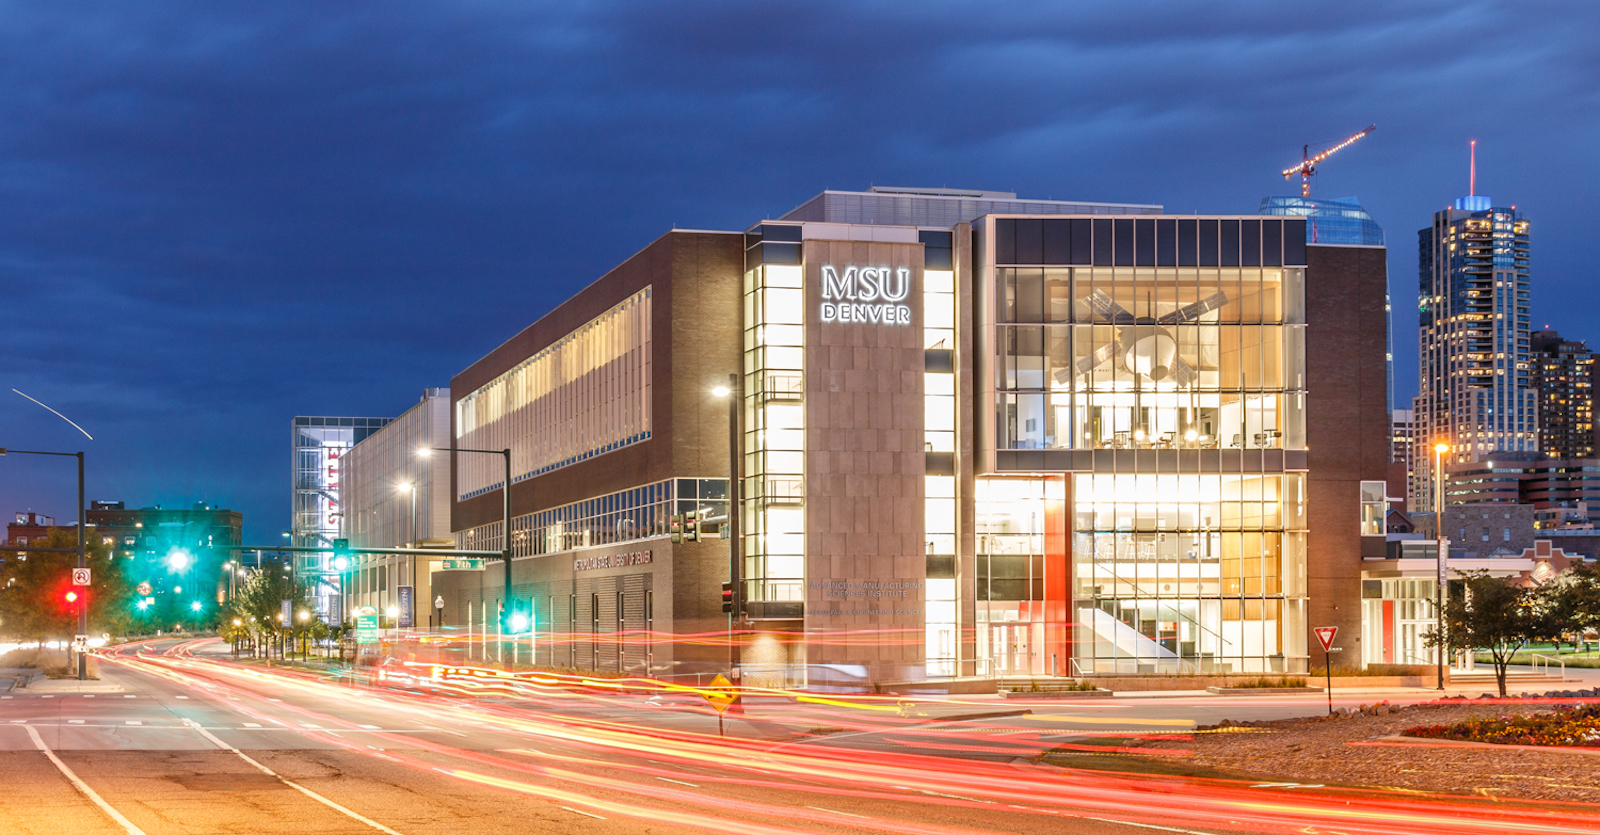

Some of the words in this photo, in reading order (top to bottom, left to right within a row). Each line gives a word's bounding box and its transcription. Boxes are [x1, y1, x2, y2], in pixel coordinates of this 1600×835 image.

[822, 267, 909, 301] MSU
[823, 304, 910, 323] DENVER
[811, 582, 853, 590] ADVANCED
[855, 582, 924, 590] MANUFACTURING
